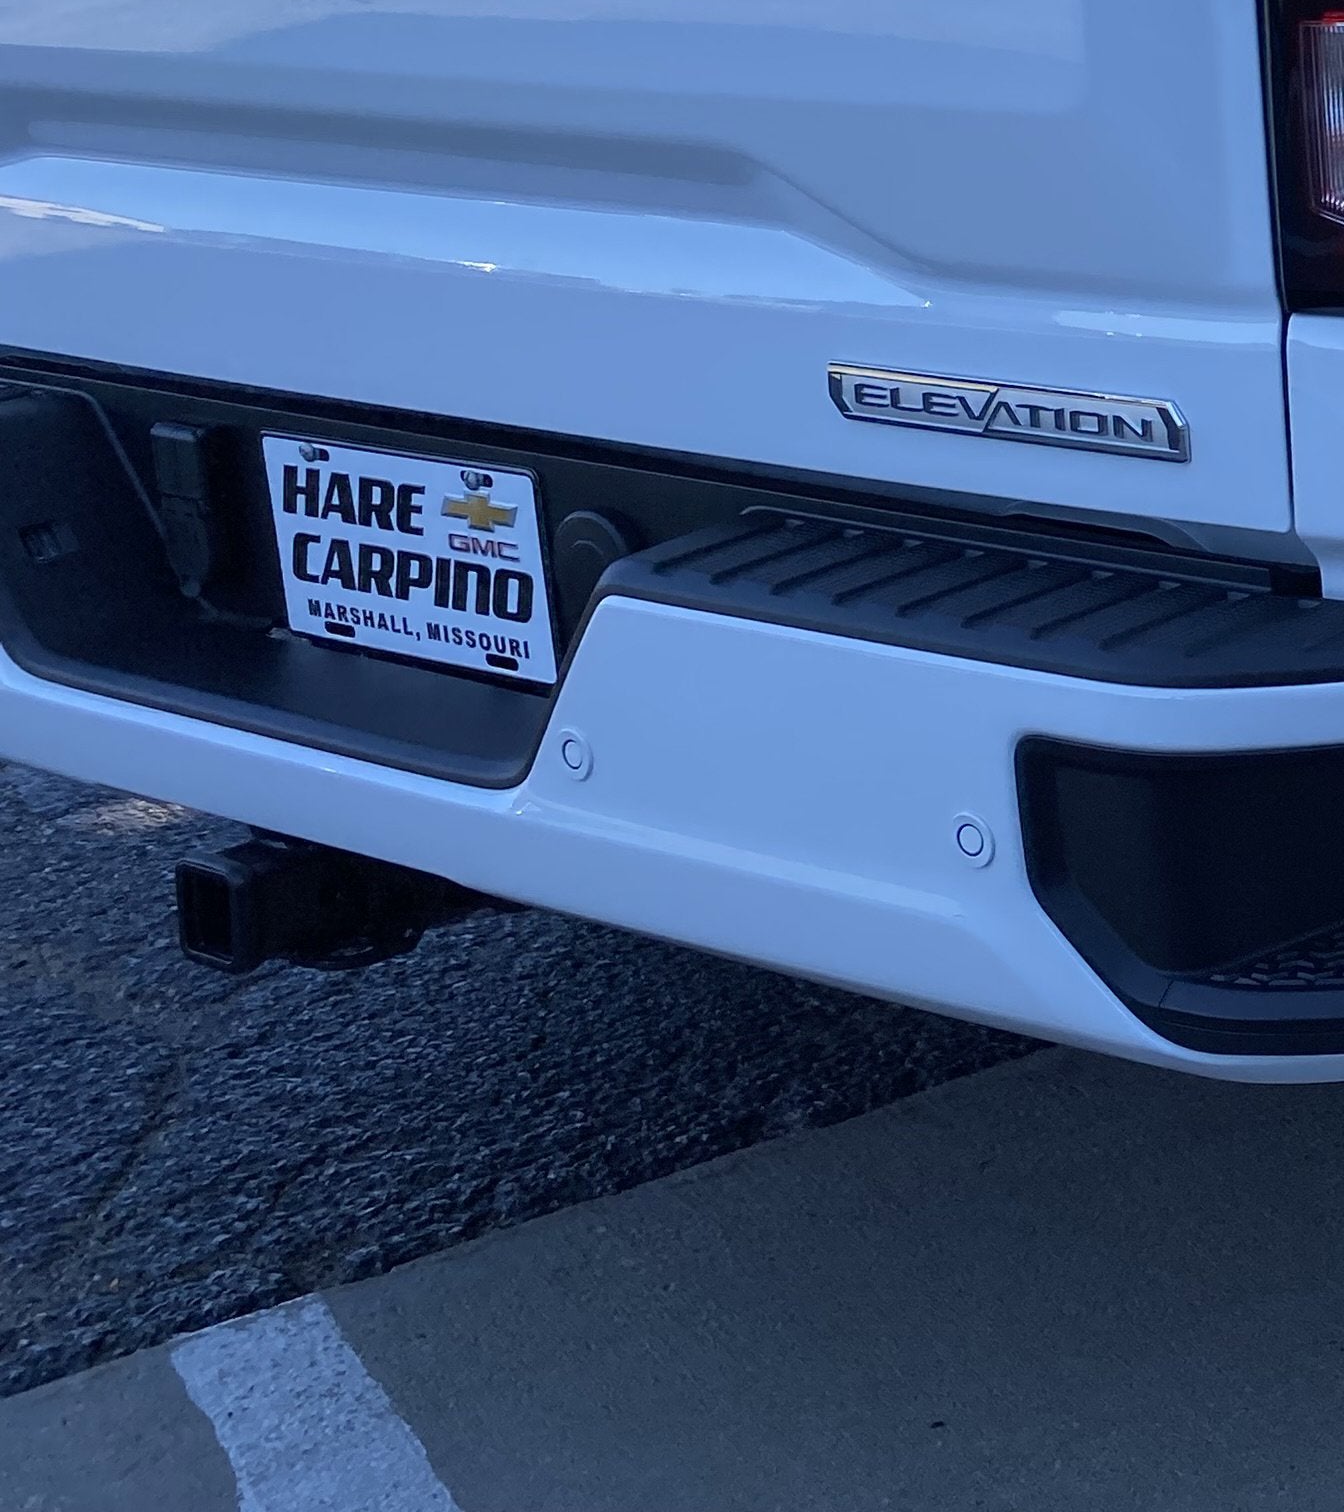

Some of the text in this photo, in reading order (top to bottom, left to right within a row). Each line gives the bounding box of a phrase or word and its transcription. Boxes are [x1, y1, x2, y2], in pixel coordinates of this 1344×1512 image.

[853, 382, 1155, 443] ELEVATION
[282, 464, 426, 537] HARE
[292, 531, 535, 624] CARPINO
[448, 533, 521, 563] GMC
[307, 598, 531, 660] MARSHALL, MISSOURI
